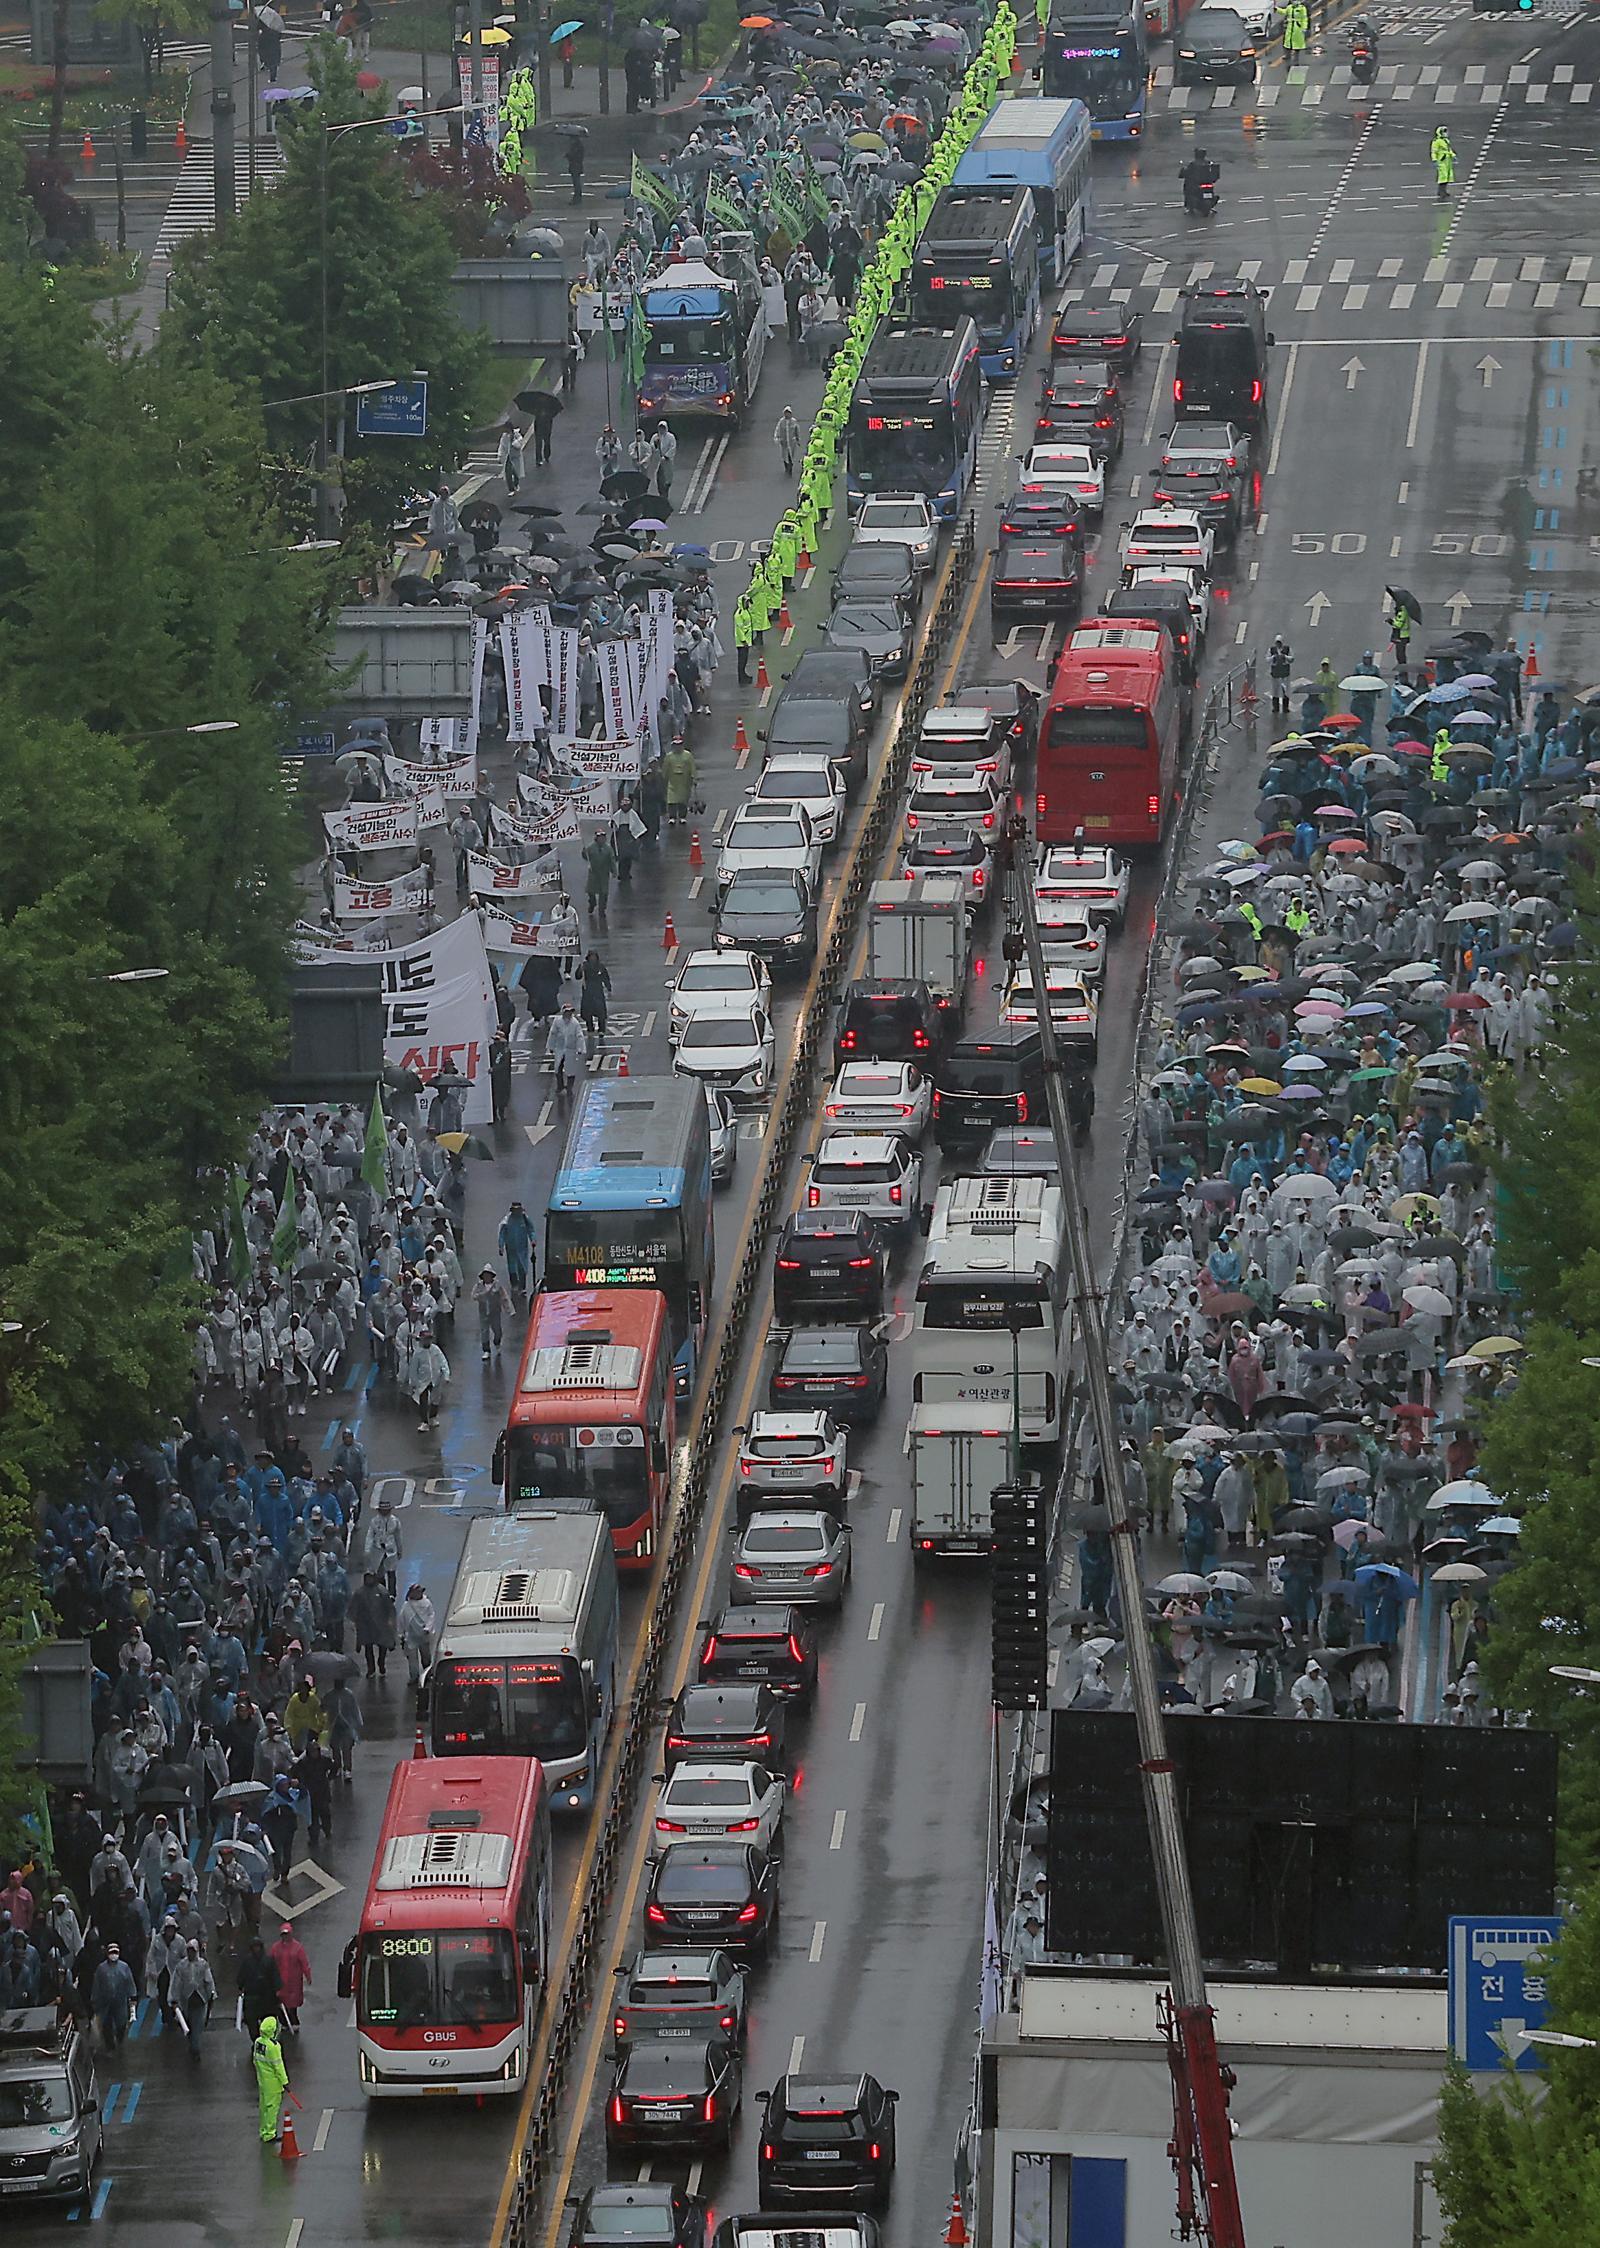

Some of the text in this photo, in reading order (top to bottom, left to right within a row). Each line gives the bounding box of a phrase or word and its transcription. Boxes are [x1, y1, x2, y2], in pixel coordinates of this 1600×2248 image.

[1291, 533, 1368, 555] 50
[1430, 533, 1508, 556] 50
[571, 751, 620, 762] 건설기능인
[582, 762, 639, 773] 생존권 사수!
[347, 819, 397, 834] 건설기능인
[360, 828, 416, 844] 생존권 사수!
[349, 888, 392, 910] 고용
[566, 1246, 605, 1264] M4108
[646, 1244, 667, 1256] 서울역
[968, 1388, 1011, 1400] 여산관광
[382, 1938, 432, 1956] 8800
